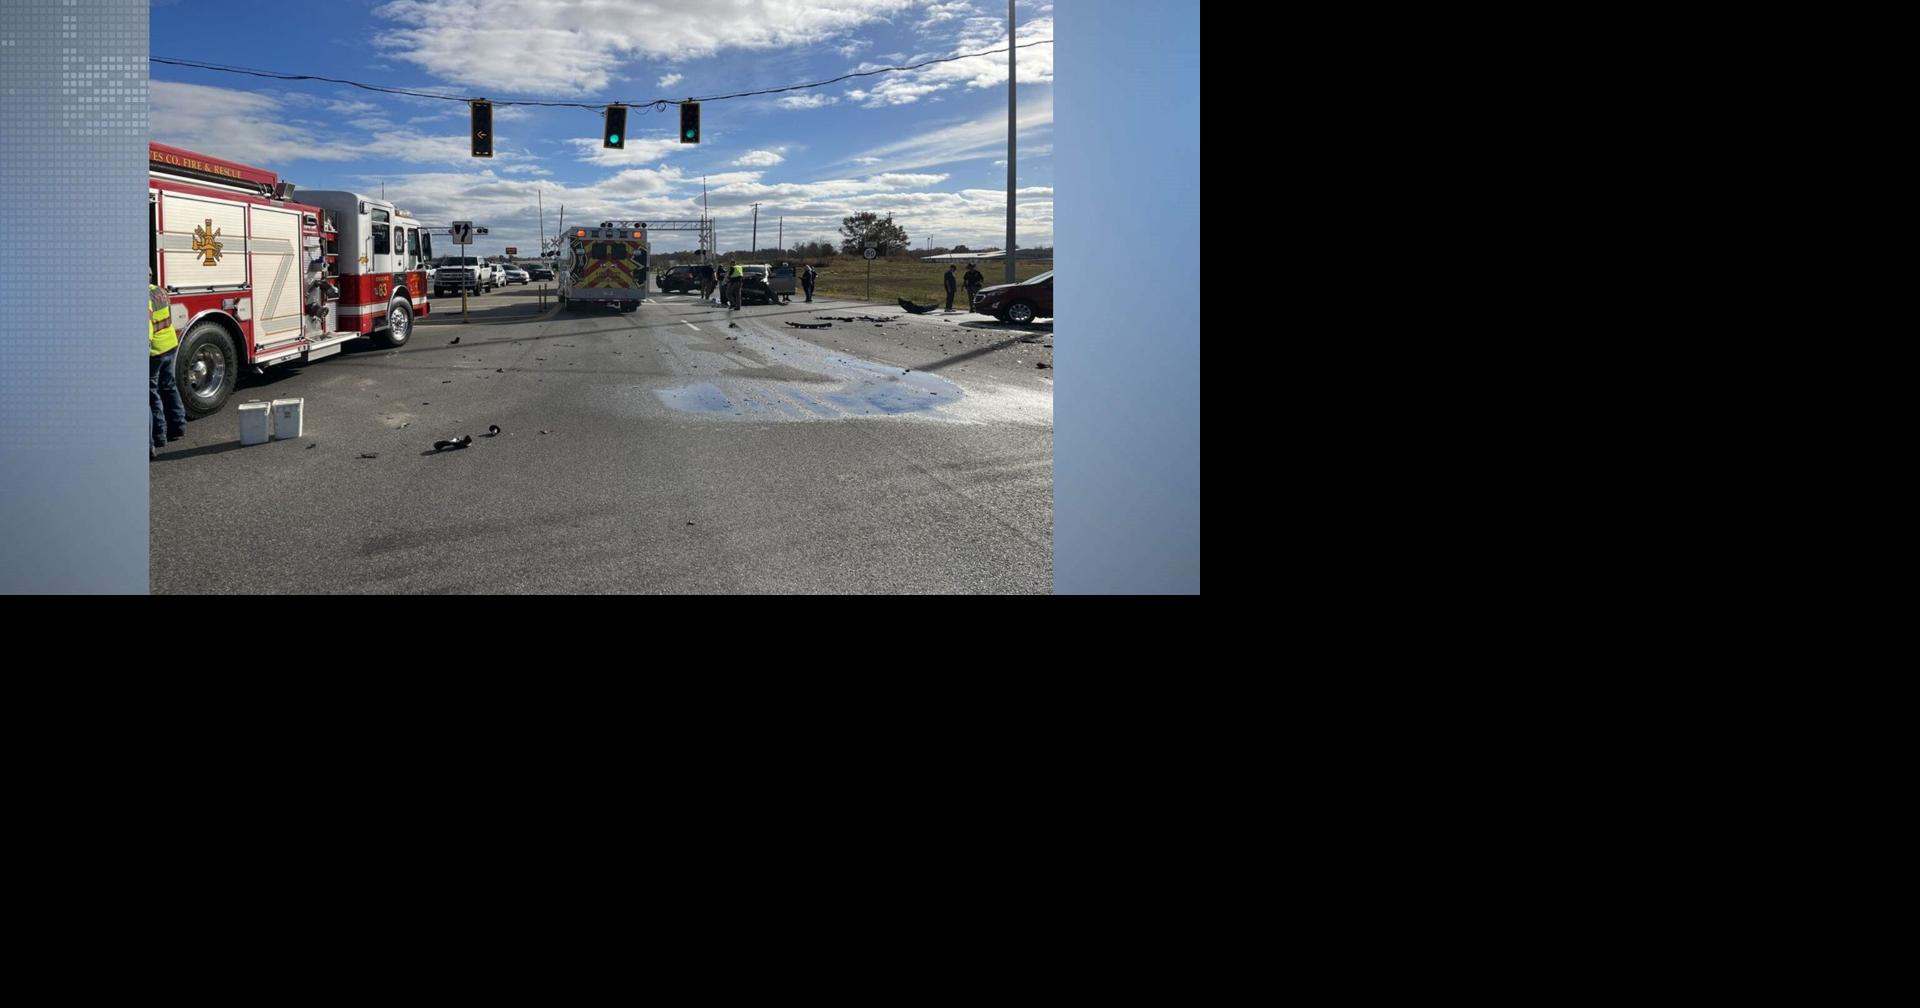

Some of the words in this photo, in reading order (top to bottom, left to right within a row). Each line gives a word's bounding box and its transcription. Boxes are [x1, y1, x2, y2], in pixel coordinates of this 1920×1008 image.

[166, 153, 181, 166] CO.
[183, 158, 202, 170] FIRE
[204, 163, 210, 172] &
[214, 165, 240, 179] RESCUE
